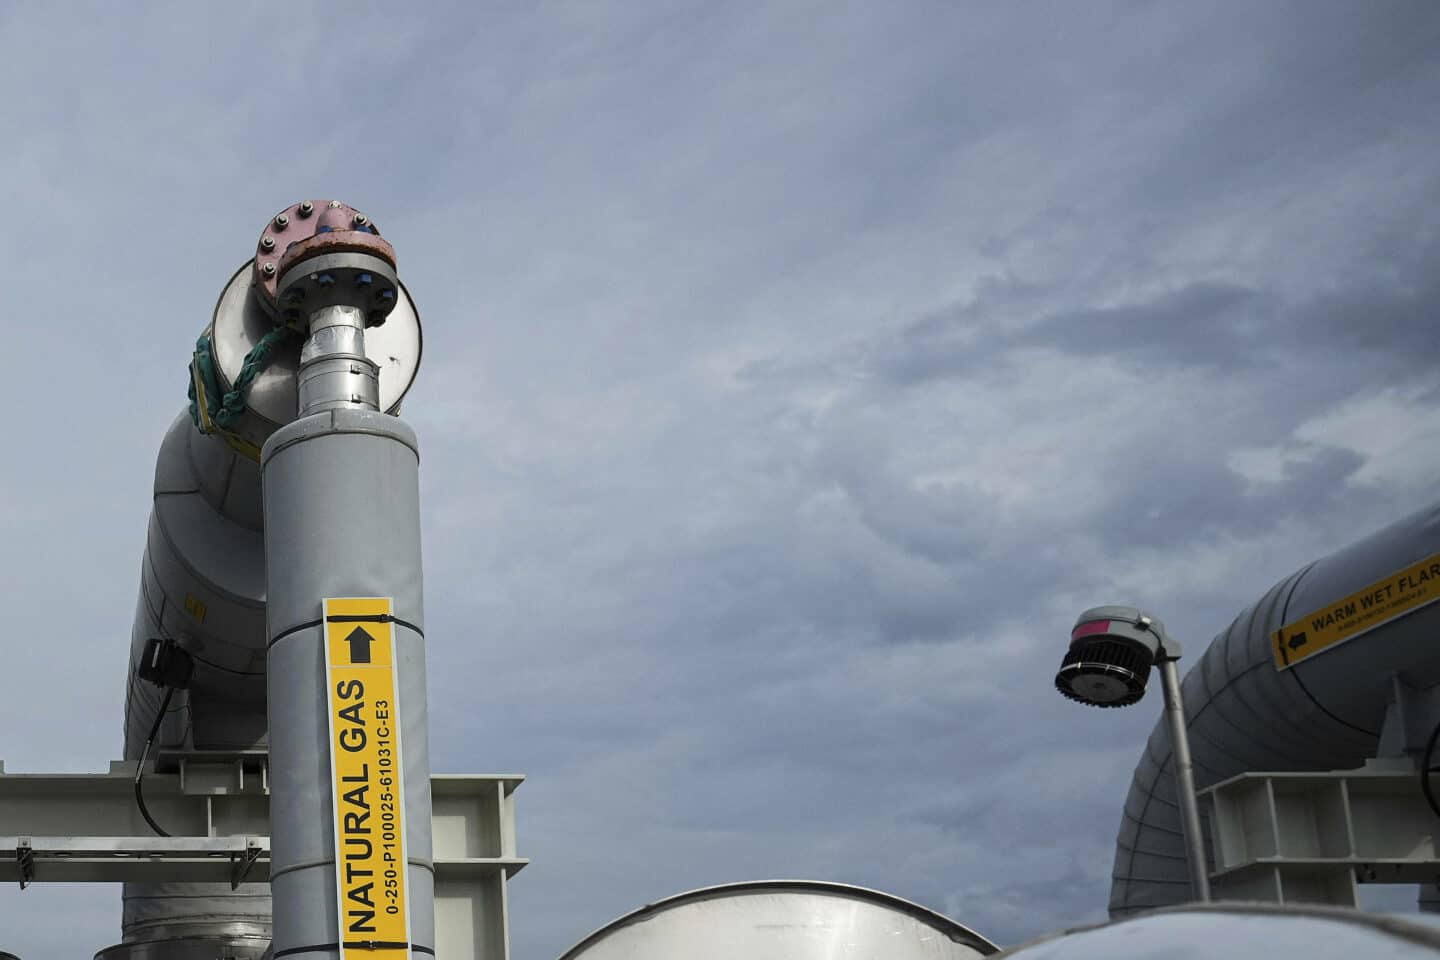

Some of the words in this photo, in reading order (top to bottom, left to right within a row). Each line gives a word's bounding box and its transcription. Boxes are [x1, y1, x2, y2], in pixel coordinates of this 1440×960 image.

[1311, 601, 1358, 632] WARM
[1360, 585, 1393, 611] WET
[336, 680, 367, 752] GAS
[342, 763, 376, 932] NATURAL
[375, 700, 398, 914] 0-250-P100025-61031C-E3
